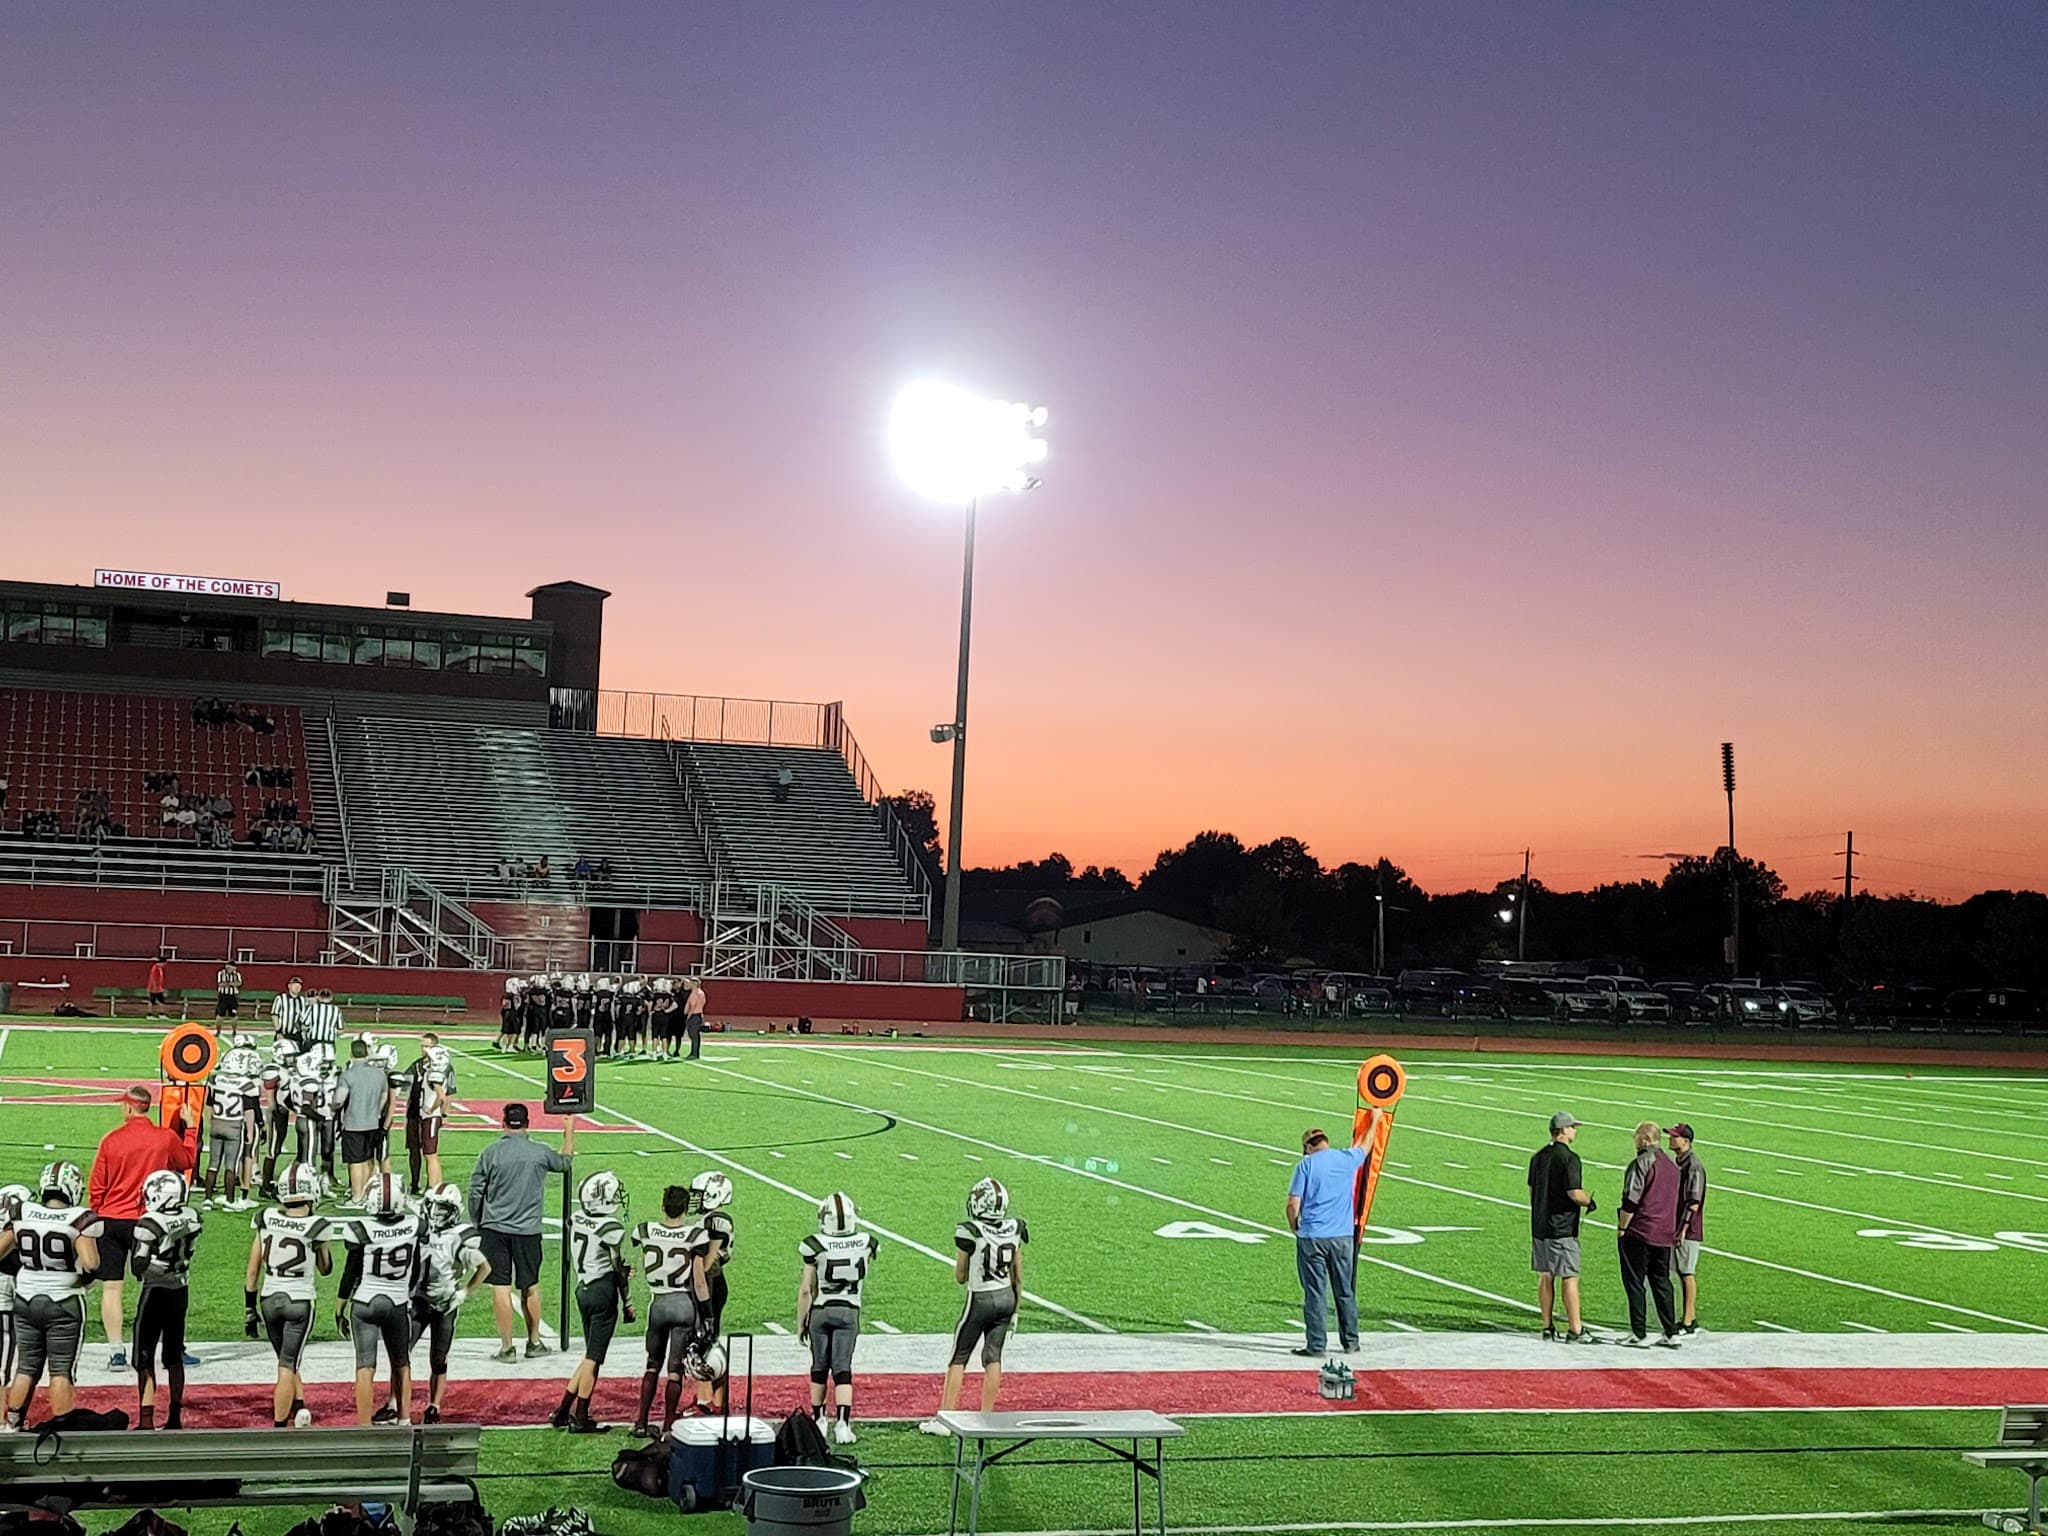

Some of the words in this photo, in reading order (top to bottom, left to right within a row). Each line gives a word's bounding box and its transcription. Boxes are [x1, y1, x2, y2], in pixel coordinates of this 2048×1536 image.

[101, 573, 146, 586] HOME
[151, 577, 171, 588] OF
[176, 579, 206, 592] THE
[211, 581, 273, 596] COMETS
[551, 1039, 587, 1082] 3
[212, 1088, 242, 1117] 52
[268, 1217, 307, 1232] TROJANS
[372, 1226, 413, 1239] TROJANS
[17, 1229, 76, 1272] 99
[262, 1234, 307, 1277] 12
[371, 1243, 414, 1280] 19
[574, 1233, 588, 1274] 7
[828, 1239, 864, 1250] TROJANS
[643, 1244, 691, 1288] 22
[821, 1257, 865, 1294] 51
